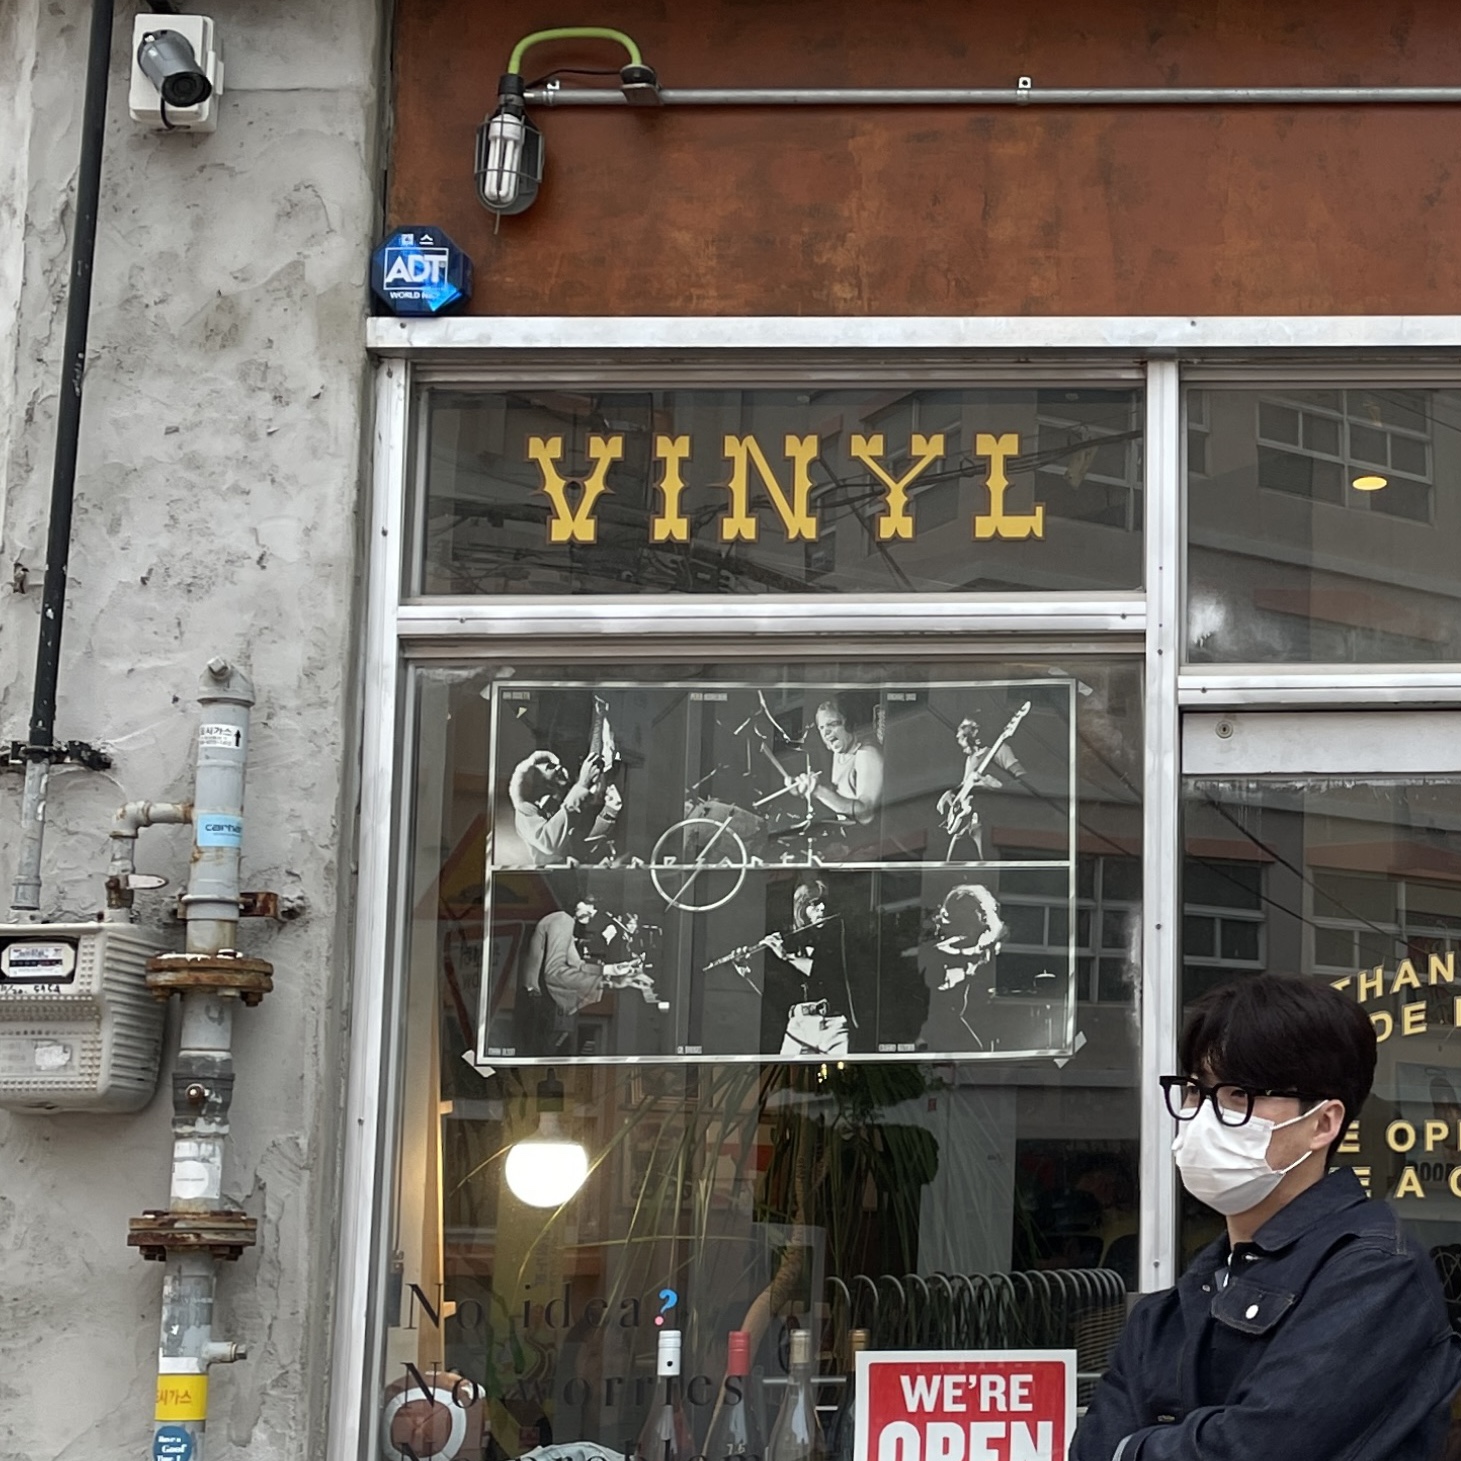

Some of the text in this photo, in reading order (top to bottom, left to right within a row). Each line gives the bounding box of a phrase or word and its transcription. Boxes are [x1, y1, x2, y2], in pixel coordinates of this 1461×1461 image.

[386, 253, 447, 284] ADT
[389, 291, 421, 299] WORLD
[526, 432, 1045, 543] VINYL
[205, 822, 243, 832] carha
[1369, 1000, 1428, 1044] DE
[1393, 1165, 1426, 1199] A
[404, 1282, 484, 1331] No
[400, 1360, 744, 1410] No worries
[899, 1373, 1034, 1413] WE'RE
